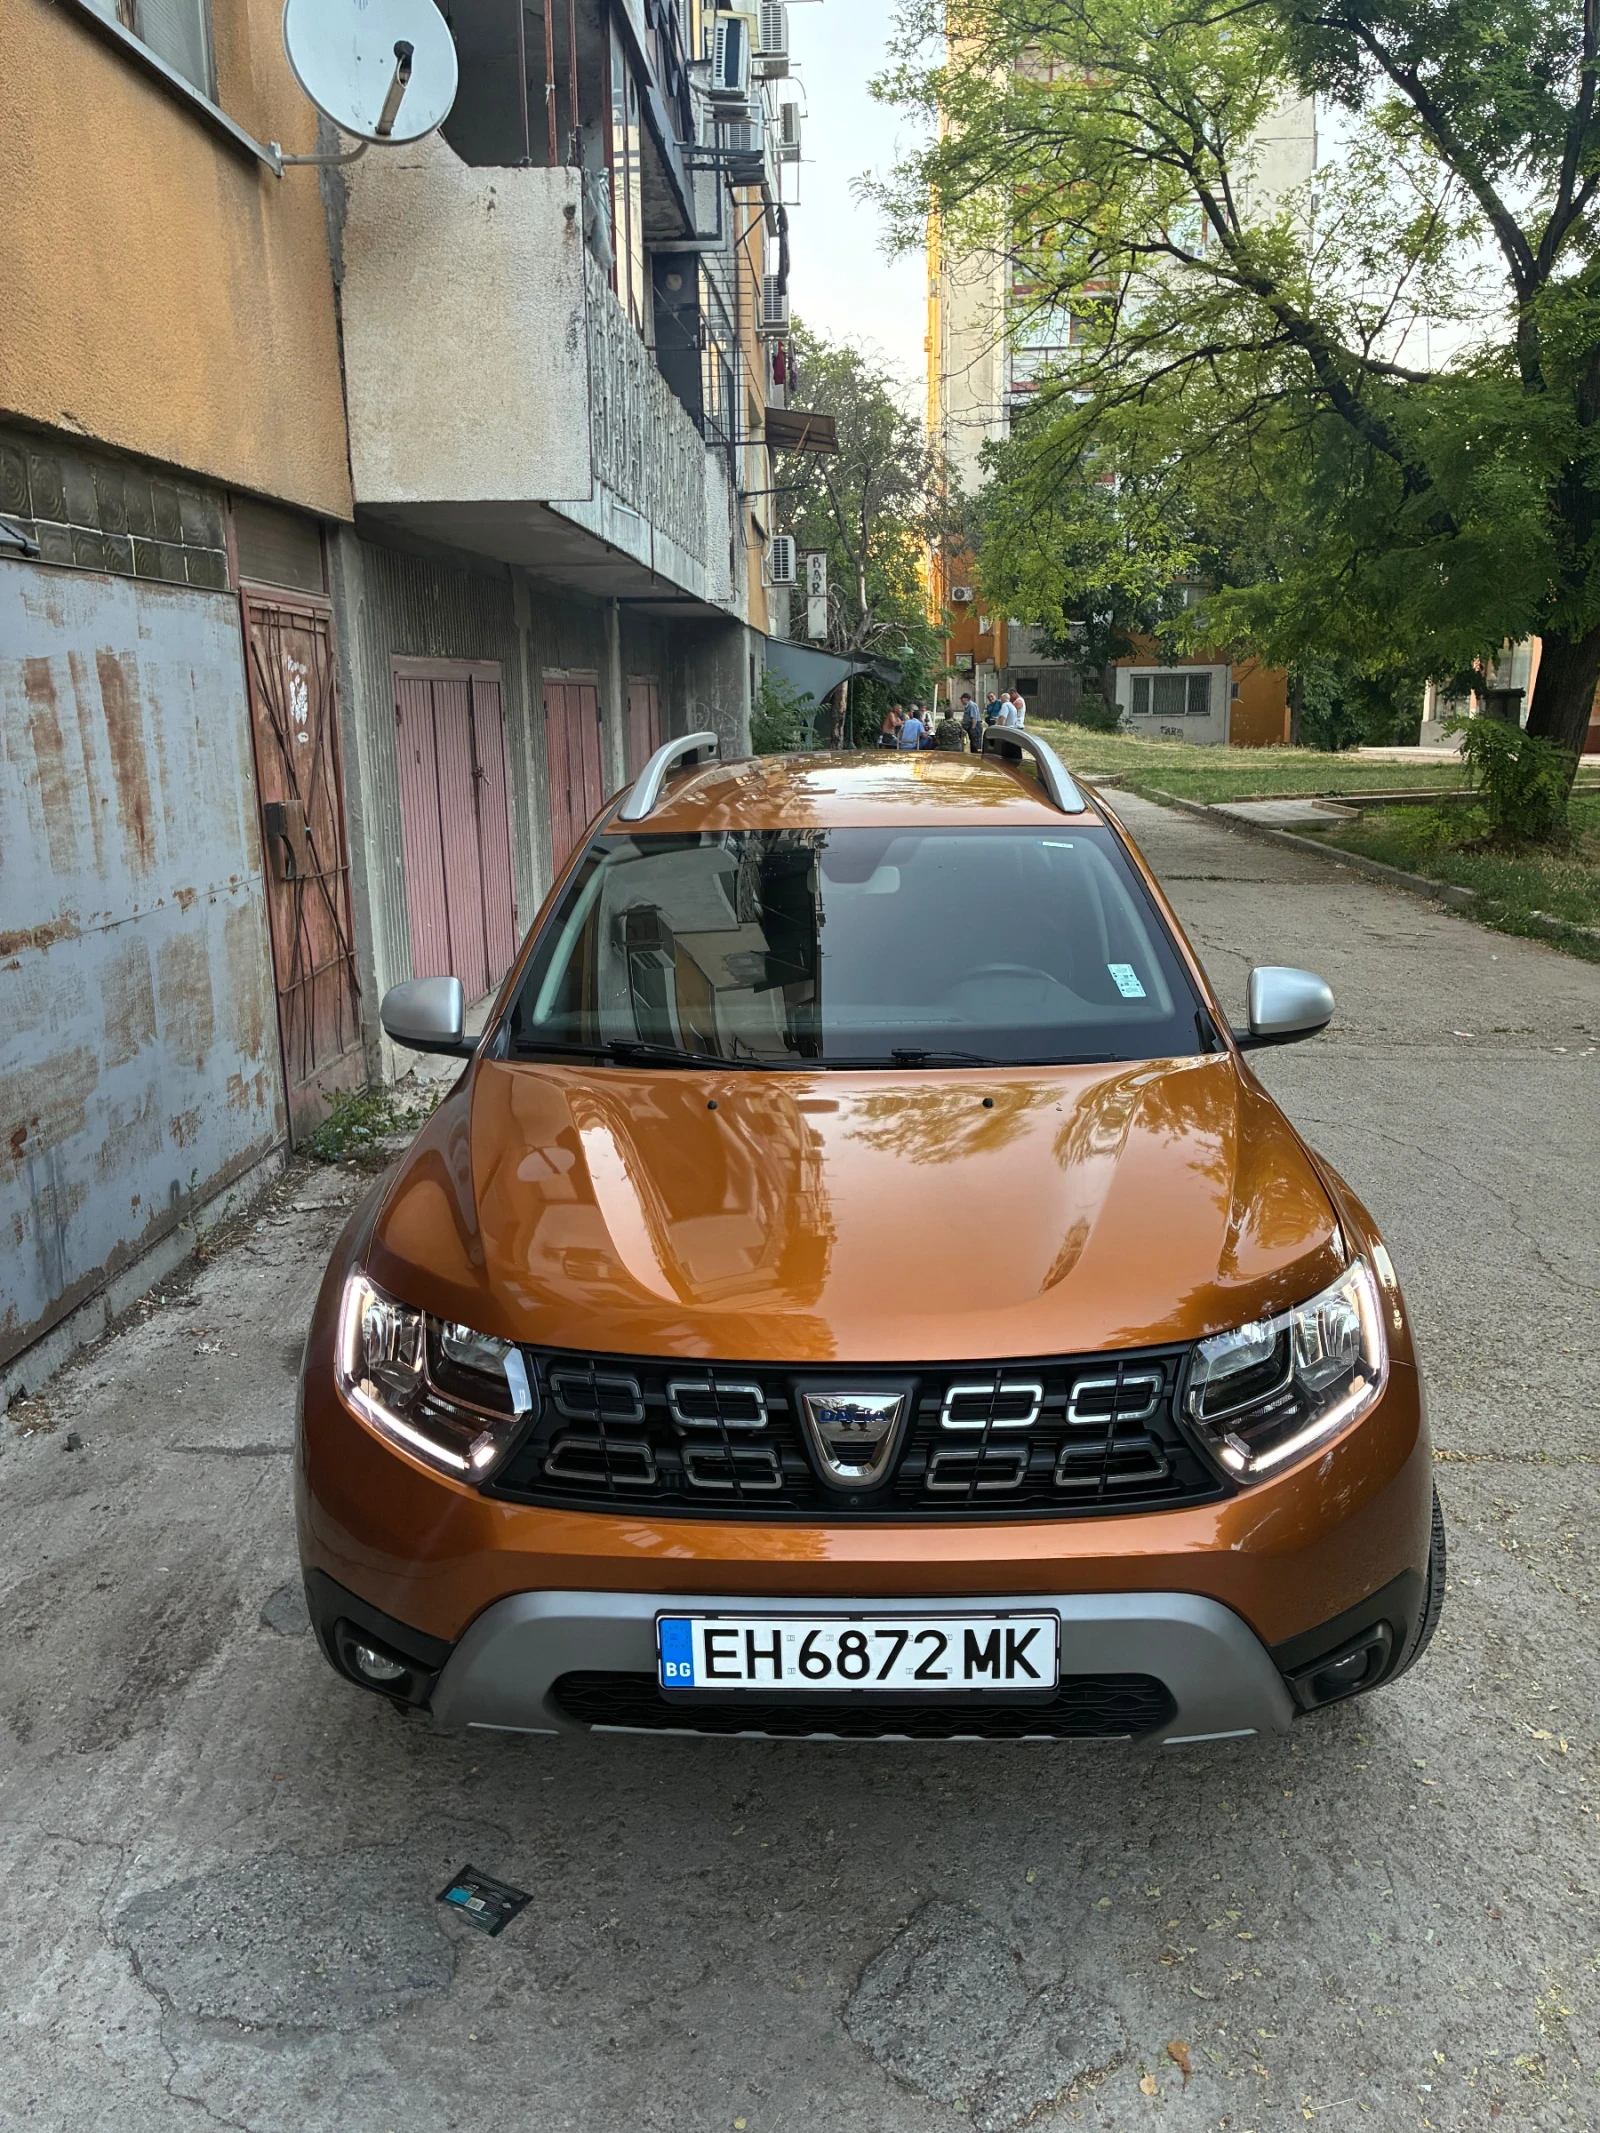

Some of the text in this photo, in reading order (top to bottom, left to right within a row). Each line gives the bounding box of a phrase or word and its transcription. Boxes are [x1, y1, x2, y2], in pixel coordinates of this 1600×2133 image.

[811, 556, 822, 595] BAR
[820, 1409, 888, 1423] DACIA
[704, 1628, 1042, 1680] EH 6872 MK
[666, 1662, 691, 1677] BG
